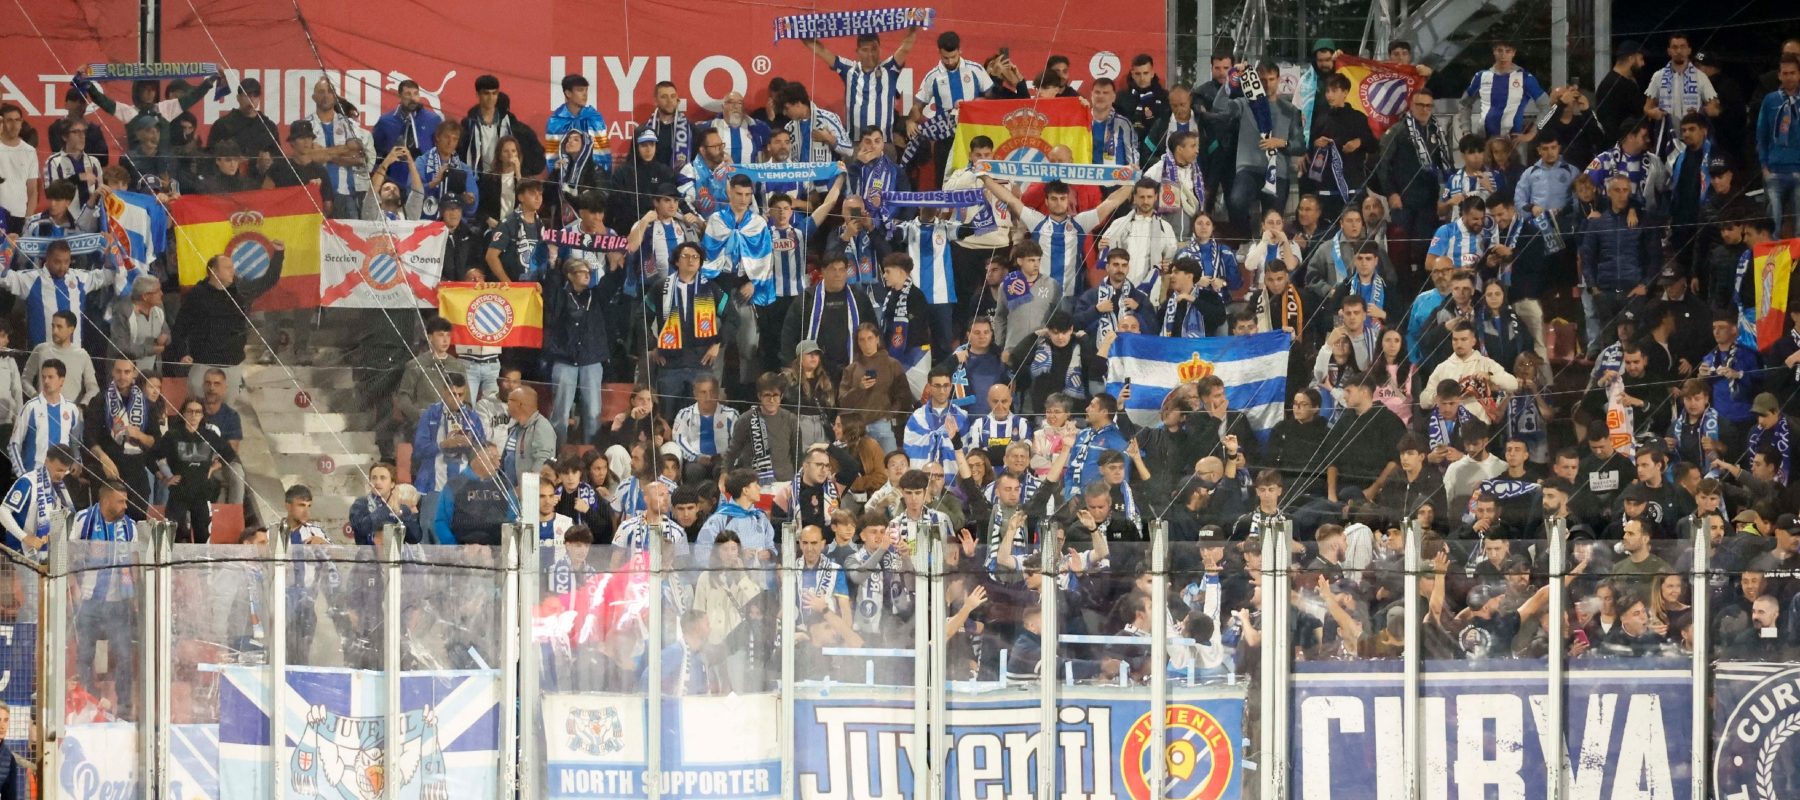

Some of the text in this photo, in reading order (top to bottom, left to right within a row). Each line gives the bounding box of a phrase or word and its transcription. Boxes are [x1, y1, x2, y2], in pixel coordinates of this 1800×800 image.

[798, 18, 837, 33] RCDE
[107, 62, 207, 77] RCD ESPANYOL
[550, 55, 748, 112] HYLO
[204, 69, 381, 125] PUMA
[1001, 138, 1053, 154] DEPORTIV
[998, 162, 1105, 180] NO SURRENDER
[542, 229, 557, 242] WE
[560, 230, 581, 246] ARE
[774, 241, 793, 249] DANI
[410, 255, 441, 264] Osona
[321, 460, 332, 469] 10
[556, 564, 570, 594] RCD
[1737, 678, 1800, 743] CUR
[326, 714, 418, 740] JUVEIL
[1301, 693, 1676, 800] CURVA
[560, 768, 769, 795] NORTH SUPPORTER
